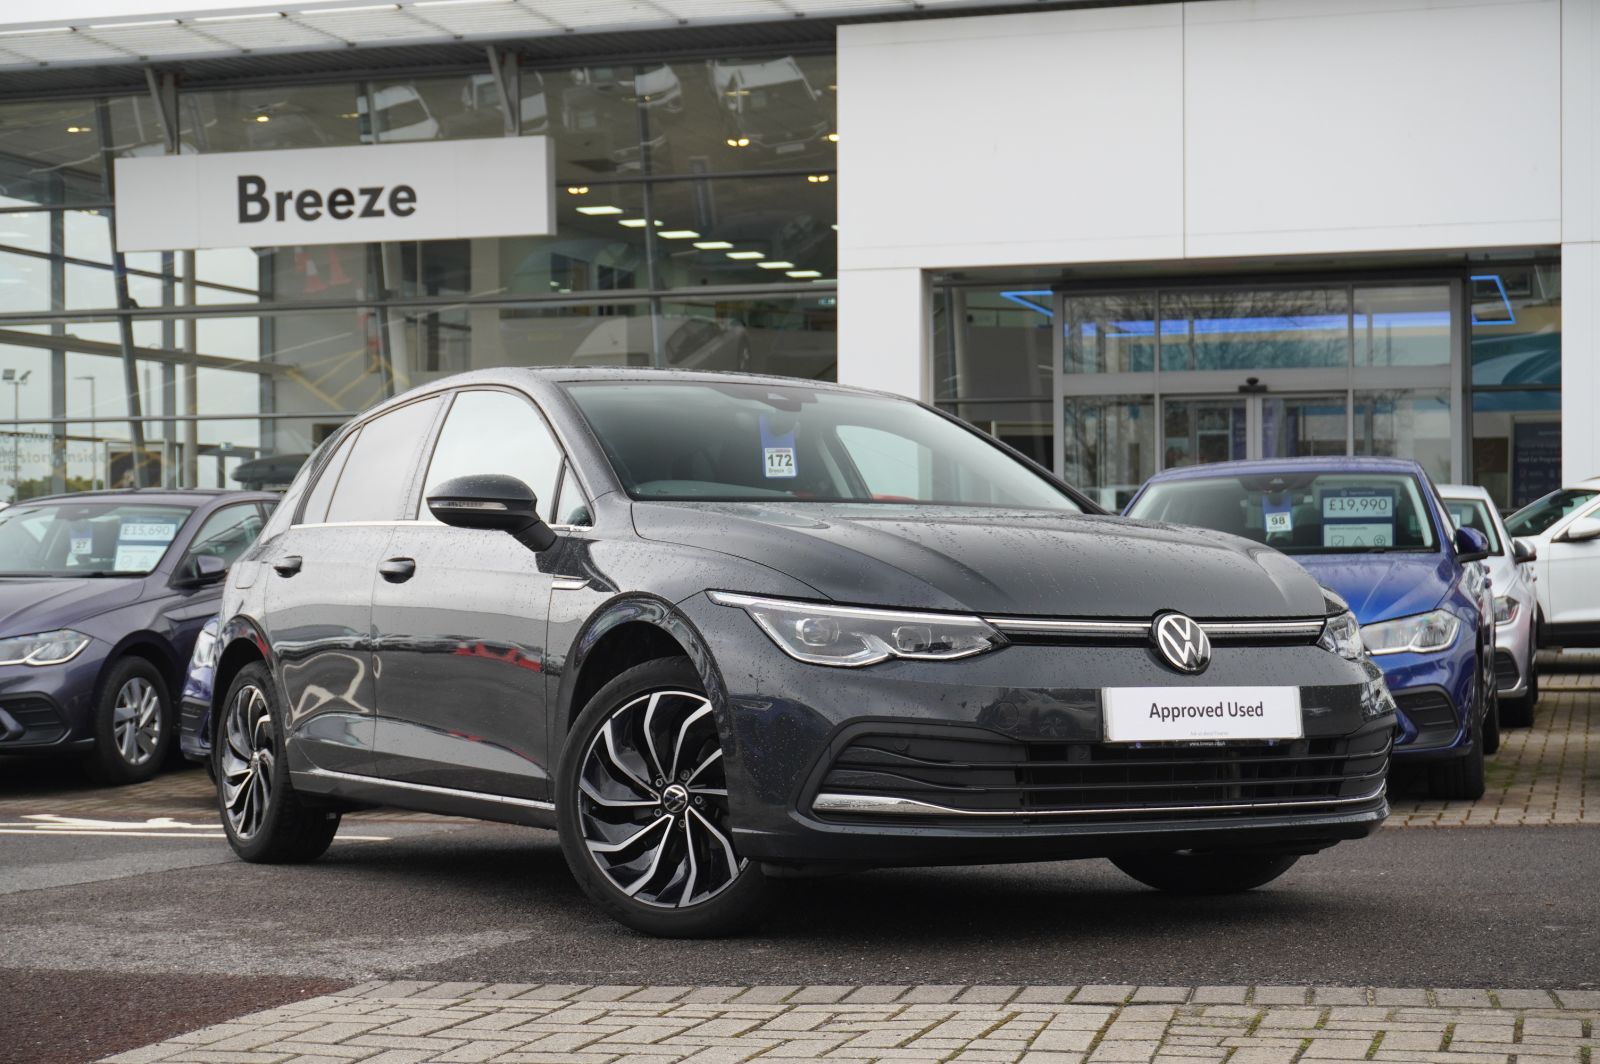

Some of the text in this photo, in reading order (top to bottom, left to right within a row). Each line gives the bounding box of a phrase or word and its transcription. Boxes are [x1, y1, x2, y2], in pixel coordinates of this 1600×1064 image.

[237, 174, 417, 224] Breeze
[768, 454, 793, 467] 172
[1329, 498, 1388, 513] £19,990
[1271, 516, 1286, 526] 98
[123, 526, 170, 536] £15,690
[1149, 701, 1264, 722] Approved Used
